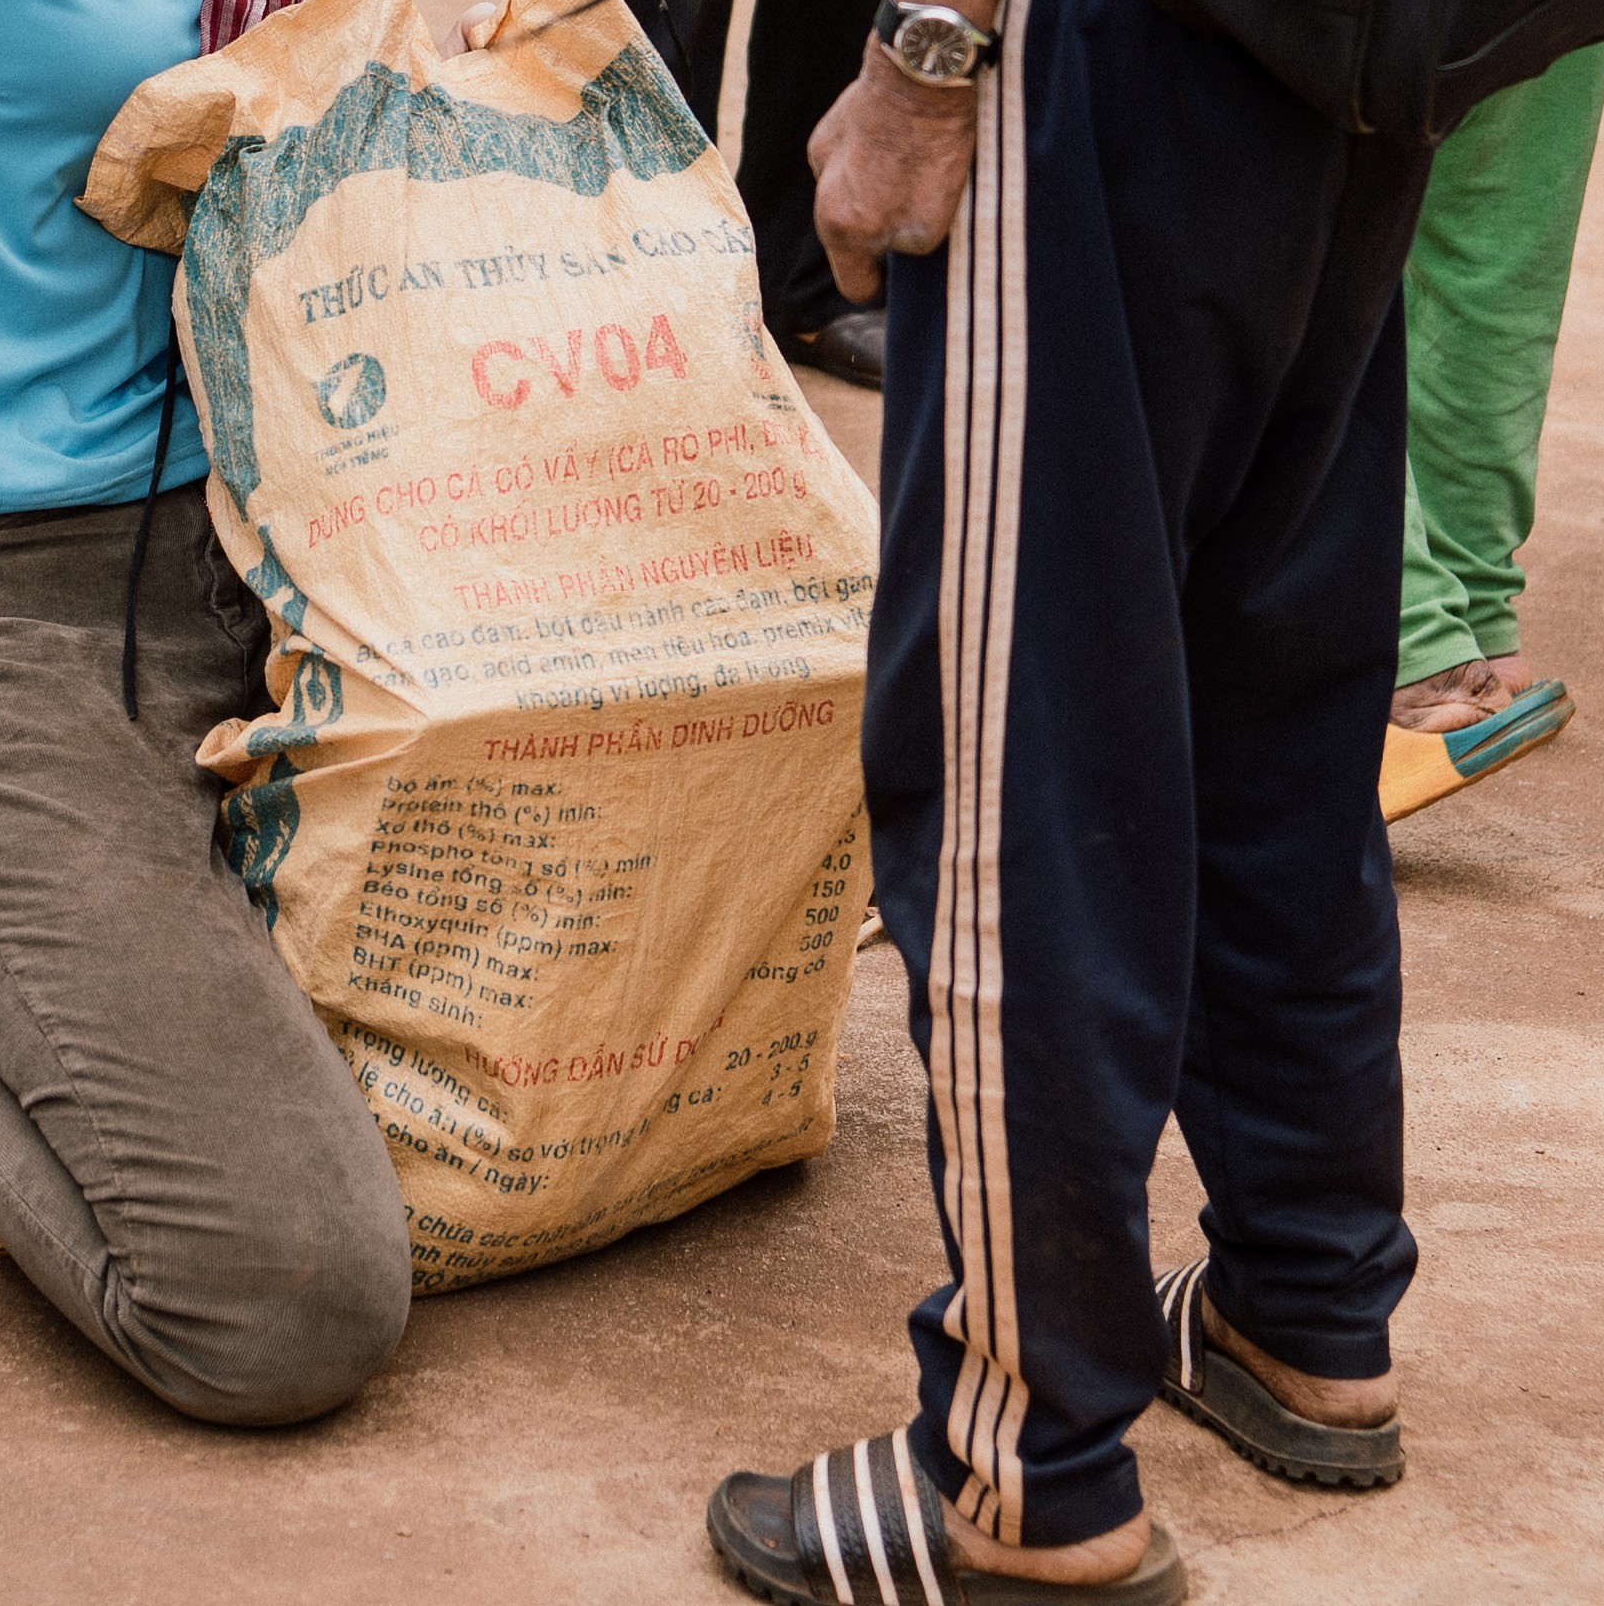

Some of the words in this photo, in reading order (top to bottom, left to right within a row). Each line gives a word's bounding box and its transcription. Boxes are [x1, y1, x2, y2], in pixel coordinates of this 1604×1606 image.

[471, 313, 688, 410] CV04
[376, 477, 437, 516] CHO
[496, 455, 534, 494] CÓ
[419, 513, 460, 553] CÓ
[692, 478, 721, 511] 20
[744, 466, 786, 500] 200
[792, 470, 809, 500] g
[640, 541, 750, 587] NGUYÊN
[420, 630, 466, 650] cao
[483, 655, 532, 680] acid
[609, 644, 658, 666] men
[762, 613, 836, 648] premix
[484, 732, 580, 762] THÀNH
[586, 718, 664, 756] PHẦN
[670, 716, 735, 750] DINH
[742, 699, 835, 740] DƯỠNG
[466, 776, 502, 797] (%)
[511, 782, 563, 796] max:
[381, 797, 463, 813] Protein
[514, 805, 550, 827] (%)
[458, 822, 496, 844] (%)
[370, 840, 474, 862] Phospho
[821, 852, 852, 873] 4,0
[363, 880, 410, 900] Béo
[417, 885, 469, 912] tổng
[511, 901, 549, 929] (%)
[366, 860, 445, 882] Lysine
[546, 883, 583, 907] (%)
[812, 879, 846, 899] 150
[359, 900, 489, 937] Ethoxyquin
[496, 924, 563, 961] (ppm)
[567, 939, 619, 956] max:
[804, 904, 840, 927] 500
[355, 923, 407, 951] BHA
[413, 937, 481, 969] (ppm)
[486, 954, 540, 982] max:
[799, 930, 834, 953] 500
[352, 945, 402, 972] BHT
[408, 957, 474, 999] (ppm)
[478, 984, 534, 1010] max:
[803, 954, 827, 976] có
[347, 970, 422, 1009] Kháng
[428, 996, 484, 1030] sinh:
[338, 1020, 407, 1068] Trọng
[410, 1050, 471, 1107] lượng
[724, 1046, 752, 1071] 20
[767, 1032, 802, 1060] 200
[770, 1062, 782, 1082] 3
[797, 1052, 812, 1073] 5
[788, 1079, 804, 1098] 5
[383, 1080, 425, 1115] cho
[462, 1123, 502, 1157] (%)
[507, 1147, 535, 1163] so
[386, 1122, 429, 1154] cho
[433, 1141, 464, 1170] ăn
[468, 1158, 483, 1176] /
[484, 1169, 551, 1196] ngày:
[417, 1212, 475, 1245] chứa
